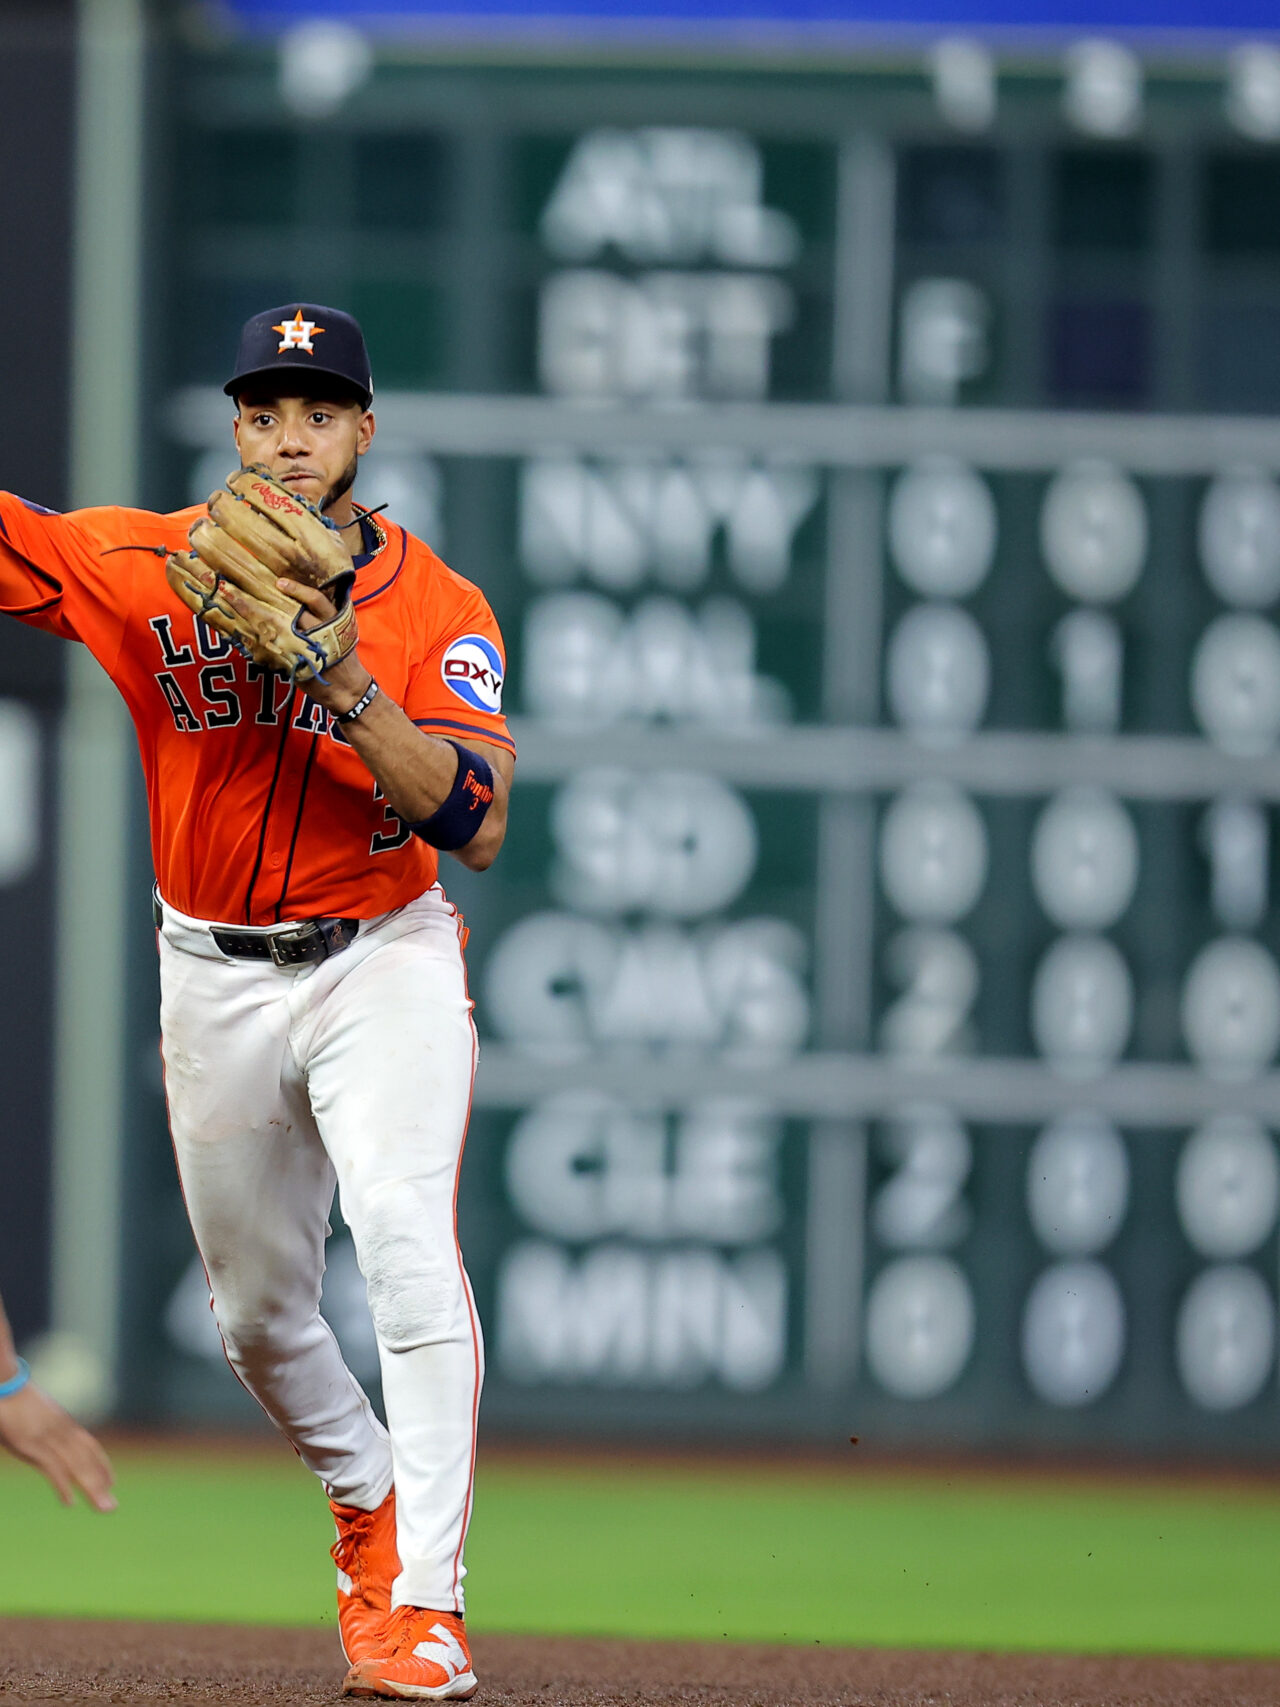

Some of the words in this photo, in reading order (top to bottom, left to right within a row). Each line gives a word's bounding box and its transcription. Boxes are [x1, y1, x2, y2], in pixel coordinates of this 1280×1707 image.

[279, 320, 315, 349] H
[521, 452, 817, 592] NYY
[148, 614, 236, 668] LO
[154, 661, 353, 747] ASTR
[445, 659, 501, 694] OXY
[499, 1241, 786, 1392] MIN
